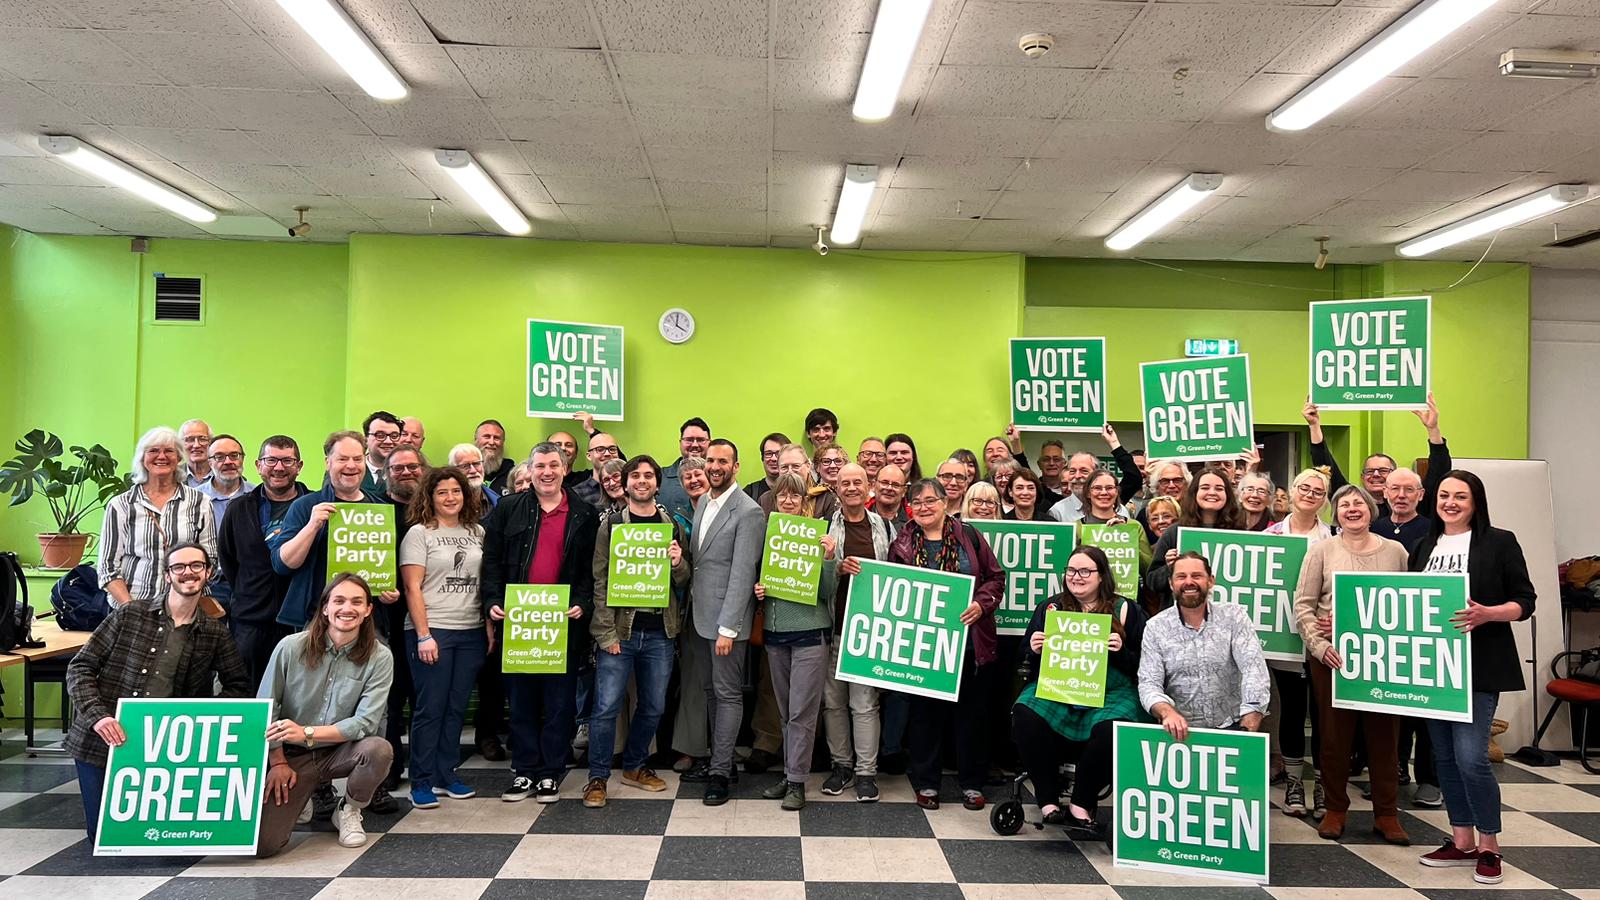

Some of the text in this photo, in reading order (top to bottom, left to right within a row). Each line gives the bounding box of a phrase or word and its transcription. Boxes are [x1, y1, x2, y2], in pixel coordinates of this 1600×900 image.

[1330, 310, 1407, 346] VOTE
[545, 331, 606, 364] VOTE
[1025, 348, 1087, 378] VOTE
[1315, 347, 1423, 387] GREEN
[532, 362, 618, 401] GREEN
[1159, 367, 1230, 403] VOTE
[1015, 379, 1100, 412] GREEN
[1375, 392, 1394, 400] Party
[1148, 400, 1247, 442] GREEN
[340, 509, 385, 526] Vote
[333, 527, 391, 544] Green
[622, 528, 663, 542] Vote
[778, 518, 817, 539] Vote
[1091, 529, 1130, 543] Vote
[436, 537, 477, 546] HERON
[614, 542, 667, 558] Green
[769, 535, 819, 557] Green
[983, 532, 1055, 569] VOTE
[335, 546, 388, 567] Party
[768, 551, 814, 577] Party
[1201, 541, 1285, 586] VOTE
[371, 571, 391, 580] Party
[616, 559, 663, 580] Party
[646, 584, 665, 592] Party
[764, 574, 813, 590] Green Party
[1117, 582, 1134, 590] Party
[517, 590, 559, 605] Vote
[872, 574, 950, 624] VOTE
[508, 606, 564, 623] Green
[1355, 587, 1443, 633] VOTE
[511, 624, 560, 645] Party
[1056, 616, 1100, 636] Vote
[543, 649, 562, 658] Party
[846, 612, 960, 674] GREEN
[1048, 634, 1104, 653] Green
[1048, 652, 1099, 676] Party
[1339, 631, 1463, 690] GREEN
[884, 668, 924, 683] Green Party
[1043, 677, 1100, 690] Green Party
[1384, 690, 1429, 704] Green Party
[143, 715, 243, 763] VOTE
[1140, 740, 1239, 794] VOTE
[109, 767, 257, 822] GREEN
[1121, 787, 1260, 851] GREEN
[161, 830, 213, 840] Green Party
[1173, 851, 1223, 865] Green Party
